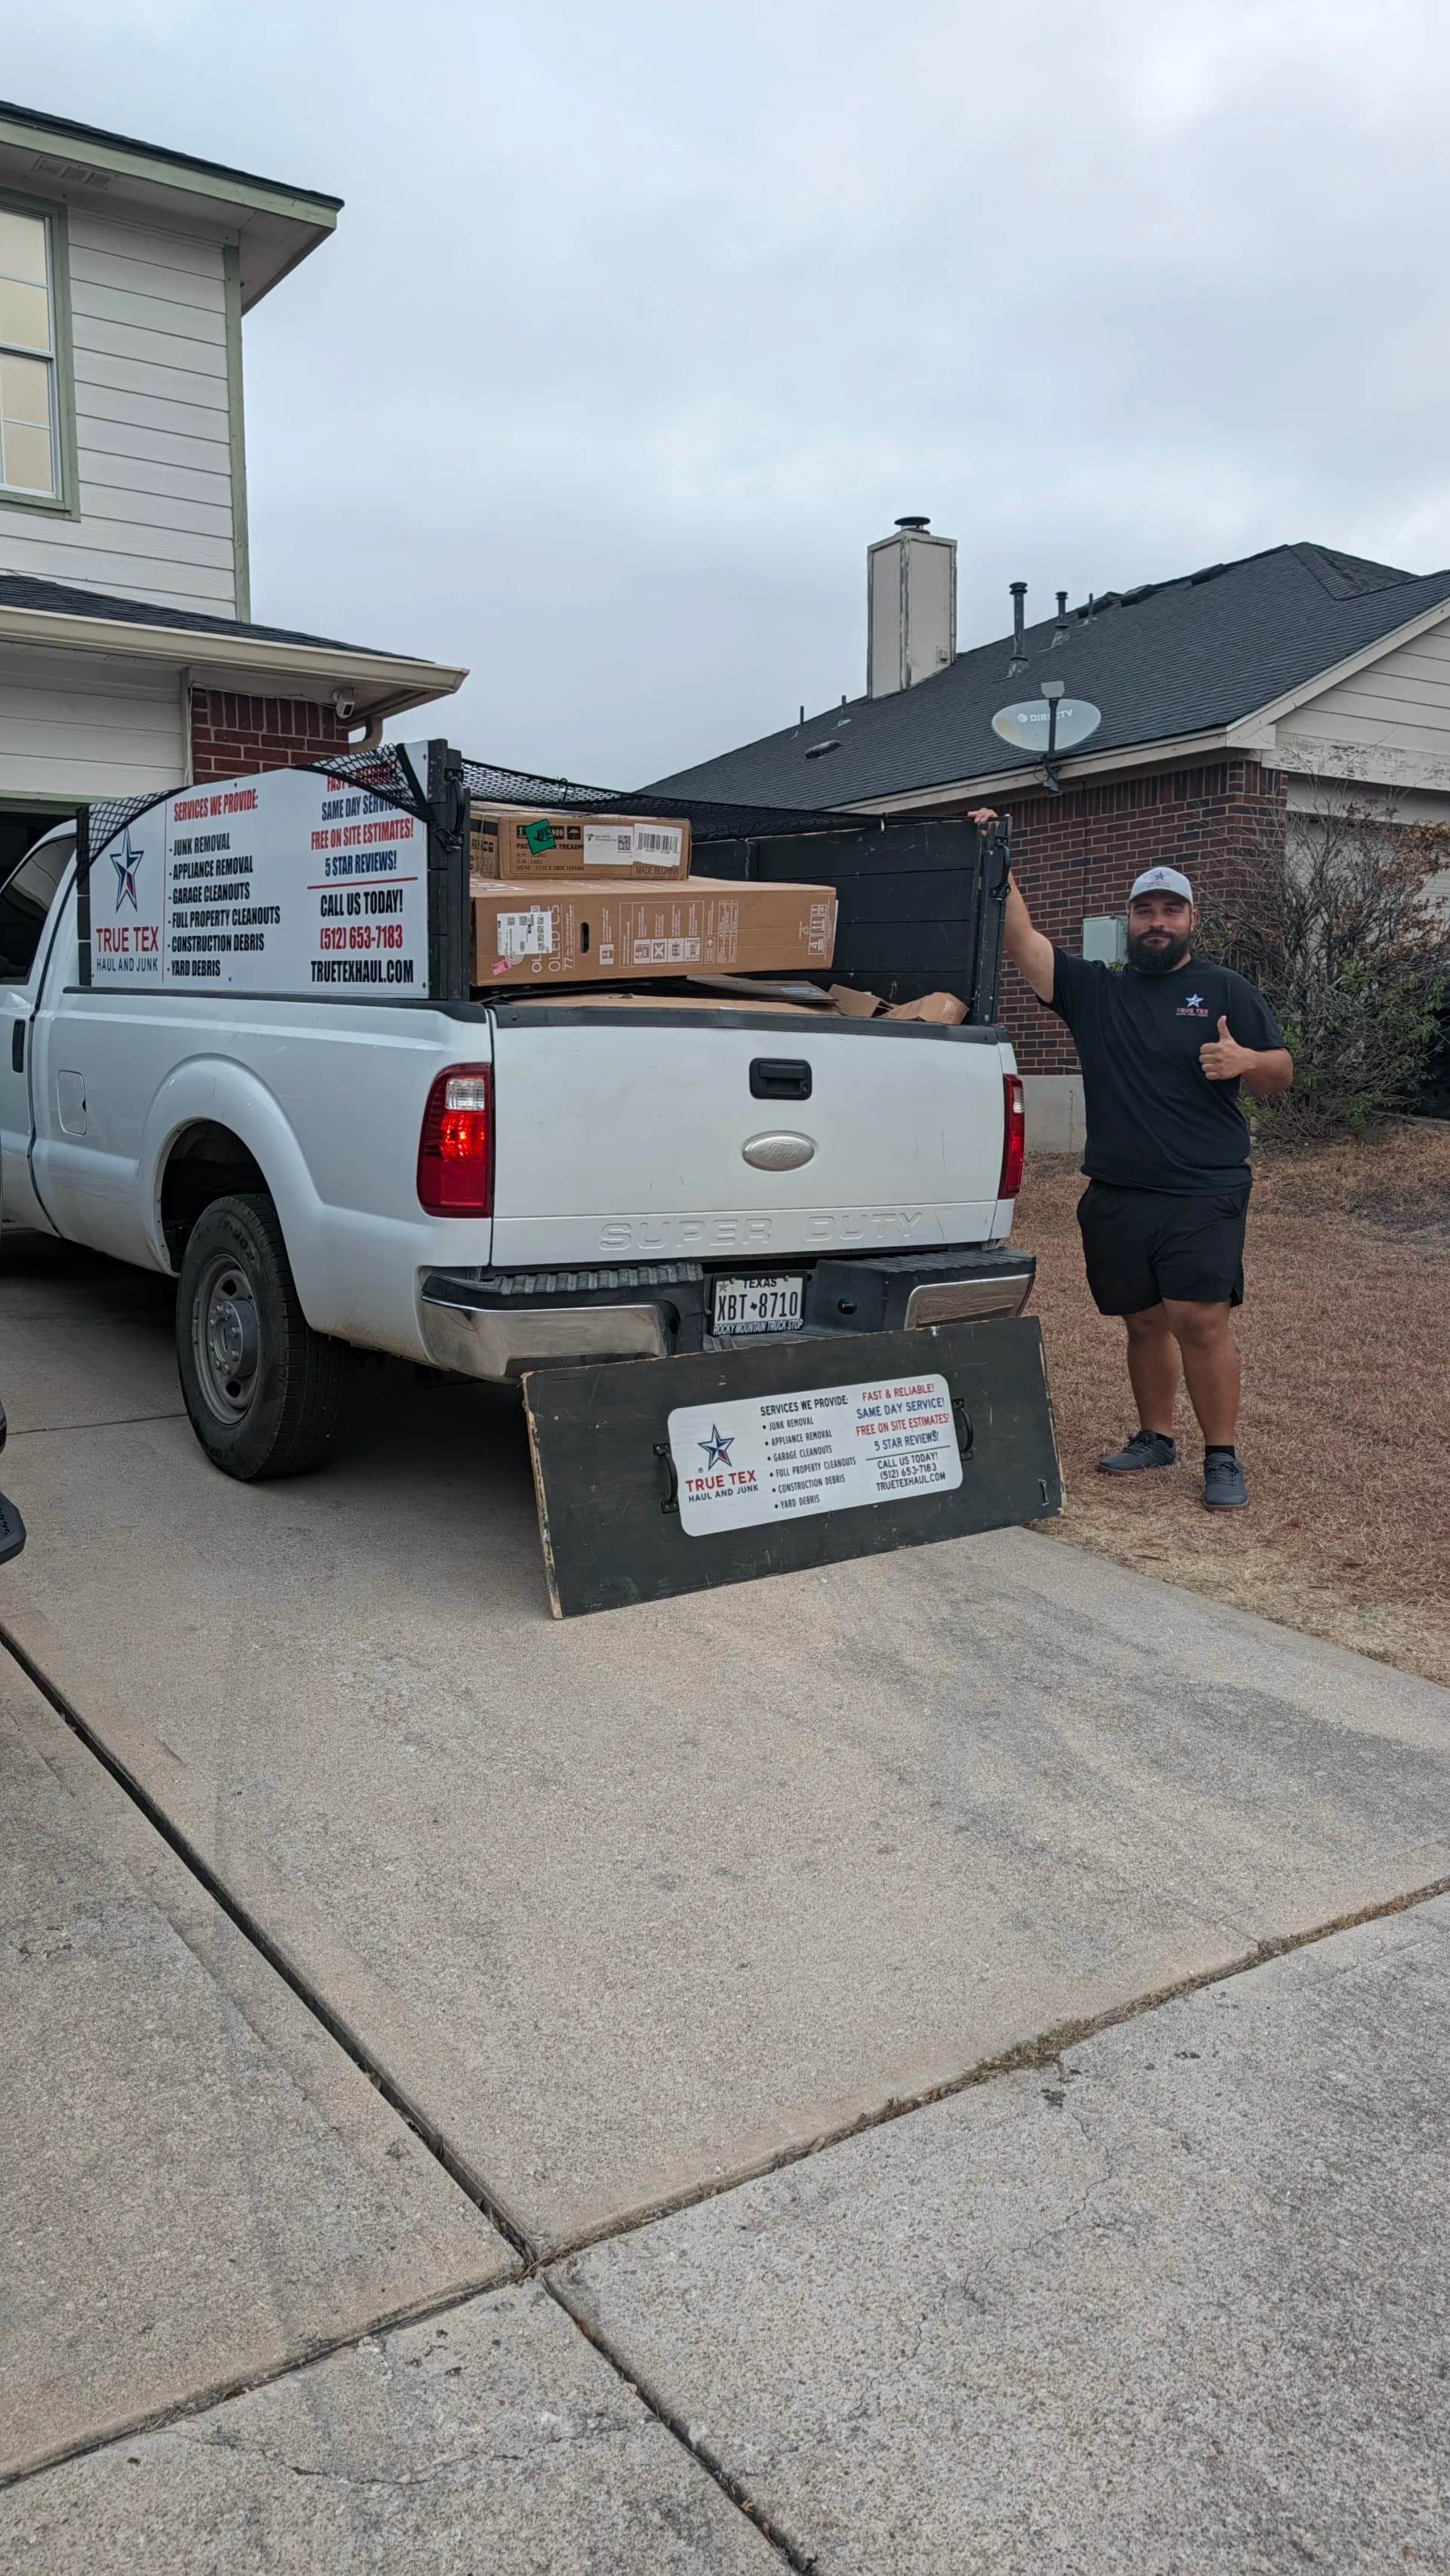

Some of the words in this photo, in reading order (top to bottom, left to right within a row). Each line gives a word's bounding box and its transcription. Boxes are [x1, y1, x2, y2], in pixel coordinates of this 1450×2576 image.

[174, 797, 209, 822] SERVICES
[210, 795, 222, 817] WE
[224, 788, 258, 814] PROVIDE:
[322, 799, 344, 821] SAME
[345, 796, 361, 817] DAY
[173, 838, 193, 857] JUNK
[194, 832, 230, 854] REMOVAL
[311, 829, 329, 851] FREE
[330, 828, 341, 848] ON
[343, 825, 361, 847] SITE
[363, 817, 414, 844] ESTIMATES!
[173, 860, 214, 881] APPLIANCE
[215, 855, 254, 876] REMOVAL
[325, 857, 331, 877] 5
[332, 854, 353, 876] STAR
[355, 850, 397, 874] REVIEWS!
[172, 886, 202, 904] GARAGE
[204, 882, 250, 903] CLEANOUTS
[320, 894, 344, 917] CALL
[347, 891, 361, 916] US
[363, 888, 403, 915] TODAY!
[172, 912, 189, 928] FULL
[190, 909, 230, 928] PROPERTY
[232, 906, 281, 926] CLEANOUTS
[96, 927, 129, 953] TRUE
[133, 925, 159, 952] TEX
[171, 934, 232, 953] CONSTRUCTION
[233, 933, 265, 951] DEBRIS
[319, 927, 347, 950] (512)
[349, 924, 403, 950] 653-7183
[96, 957, 116, 972] HAUL
[118, 957, 134, 971] AND
[136, 957, 159, 972] JUNK
[171, 960, 190, 977] YARD
[191, 959, 221, 977] DEBRIS
[310, 959, 414, 984] TRUETEXHAUL.COM
[599, 1218, 773, 1251] SUPER
[804, 1212, 922, 1242] DUTY
[743, 1278, 777, 1289] TEXAS
[717, 1294, 748, 1321] XBT
[758, 1291, 798, 1319] 8710
[713, 1322, 736, 1336] ROCKY
[736, 1320, 767, 1334] MOUNTAIN
[767, 1320, 786, 1331] TRUCK
[787, 1318, 804, 1330] STOP
[862, 1390, 882, 1402] FAST
[885, 1389, 892, 1399] &
[893, 1383, 935, 1398] RELIABLE!
[760, 1402, 799, 1416] SERVICES
[801, 1400, 813, 1411] WE
[814, 1395, 849, 1409] PROVIDE:
[856, 1406, 882, 1419] SAME
[884, 1403, 903, 1416] DAY
[905, 1397, 946, 1412] SERVICE!
[769, 1421, 785, 1431] JUNK
[787, 1416, 813, 1429] REMOVAL
[856, 1424, 876, 1436] FREE
[878, 1422, 889, 1434] ON
[890, 1419, 907, 1432] SITE
[909, 1413, 950, 1429] ESTIMATES!
[771, 1433, 804, 1447] APPLIANCE
[806, 1429, 832, 1441] REMOVAL
[874, 1441, 881, 1451] 5
[882, 1437, 903, 1450] STAR
[905, 1431, 940, 1446] REVIEWS!
[773, 1450, 797, 1462] GARAGE
[799, 1444, 832, 1458] CLEANOUTS
[877, 1459, 898, 1469] CALL
[899, 1456, 910, 1466] US
[911, 1451, 939, 1464] TODAY!
[776, 1468, 790, 1478] FULL
[792, 1462, 821, 1475] PROPERTY
[823, 1456, 856, 1470] CLEANOUTS
[880, 1469, 899, 1481] (512)
[901, 1463, 937, 1477] 653-7183
[685, 1475, 725, 1493] TRUE
[728, 1470, 757, 1486] TEX
[778, 1478, 823, 1493] CONSTRUCTION
[825, 1474, 846, 1486] DEBRIS
[876, 1471, 946, 1492] TRUETEXHAUL.COM
[688, 1492, 712, 1503] HAUL
[715, 1488, 733, 1498] AND
[736, 1484, 759, 1495] JUNK
[780, 1498, 797, 1509] YARD
[799, 1494, 820, 1506] DEBRIS
